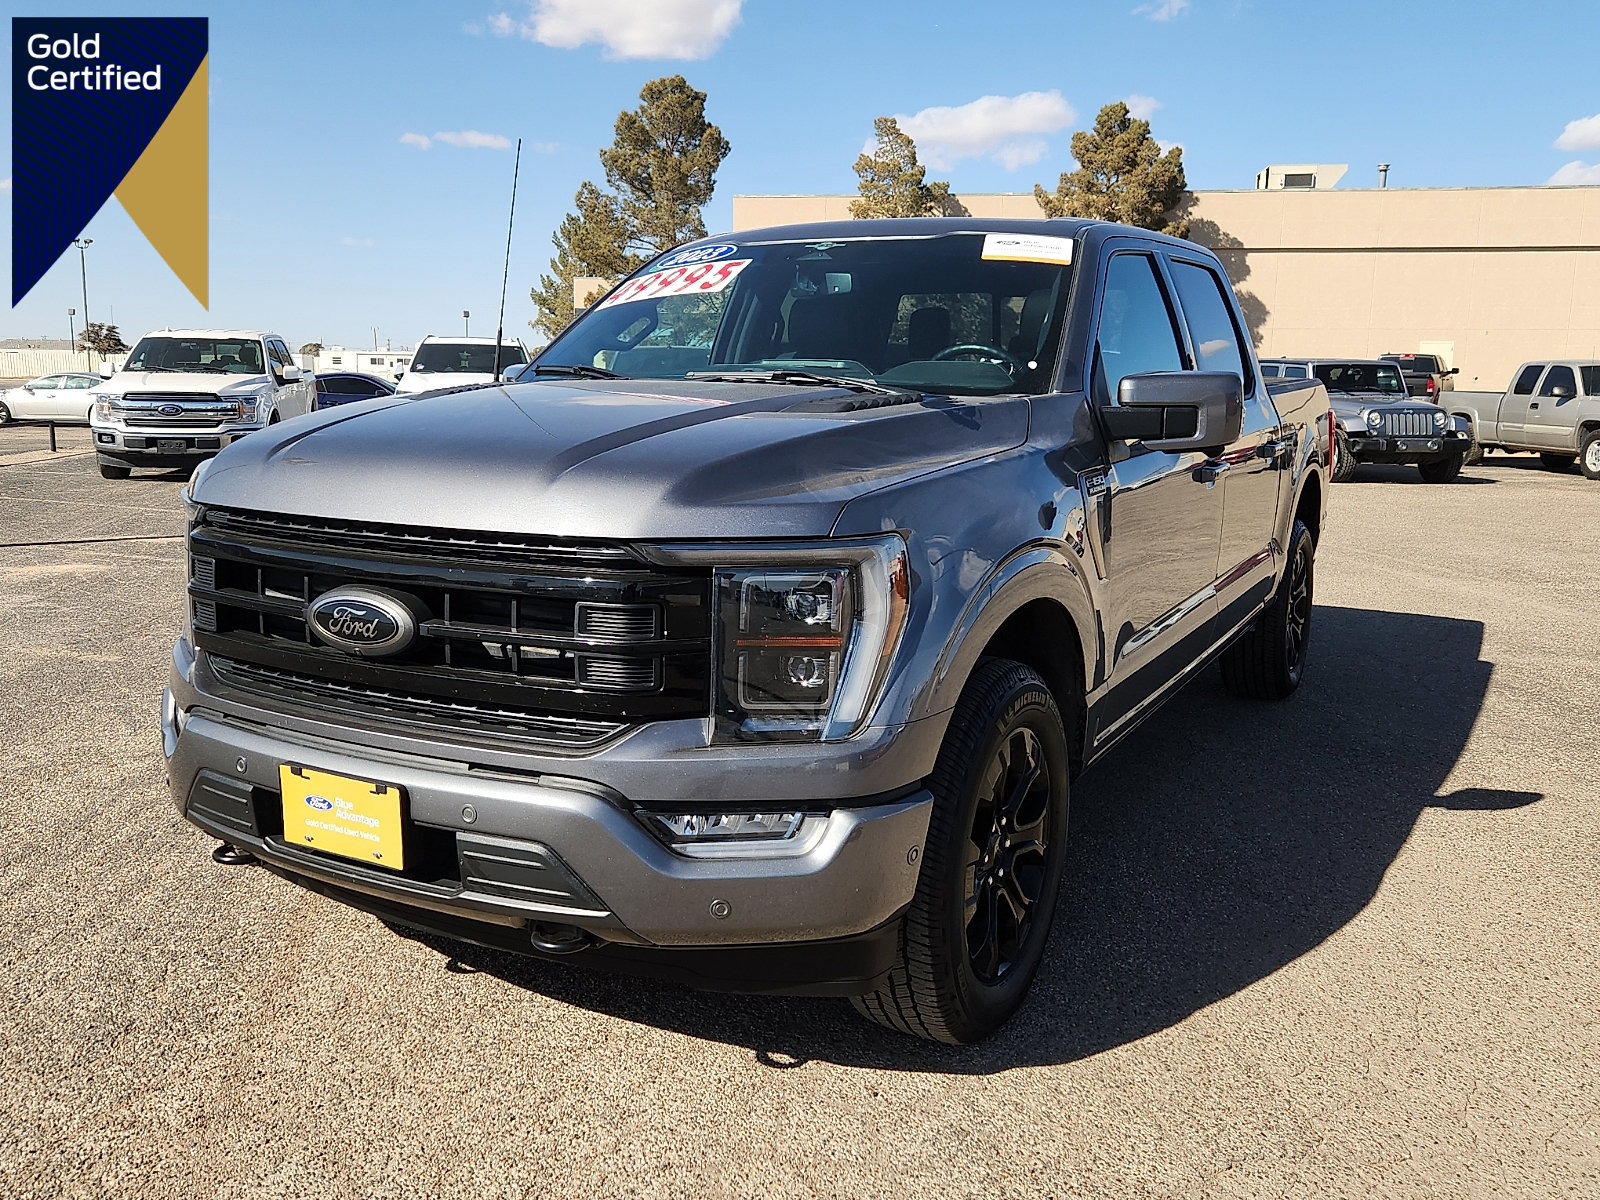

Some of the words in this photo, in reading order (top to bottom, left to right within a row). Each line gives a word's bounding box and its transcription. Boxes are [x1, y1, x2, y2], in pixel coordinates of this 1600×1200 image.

[328, 606, 379, 639] Ford
[309, 797, 329, 810] Ford
[334, 797, 354, 810] Blue
[335, 808, 380, 828] Advantage
